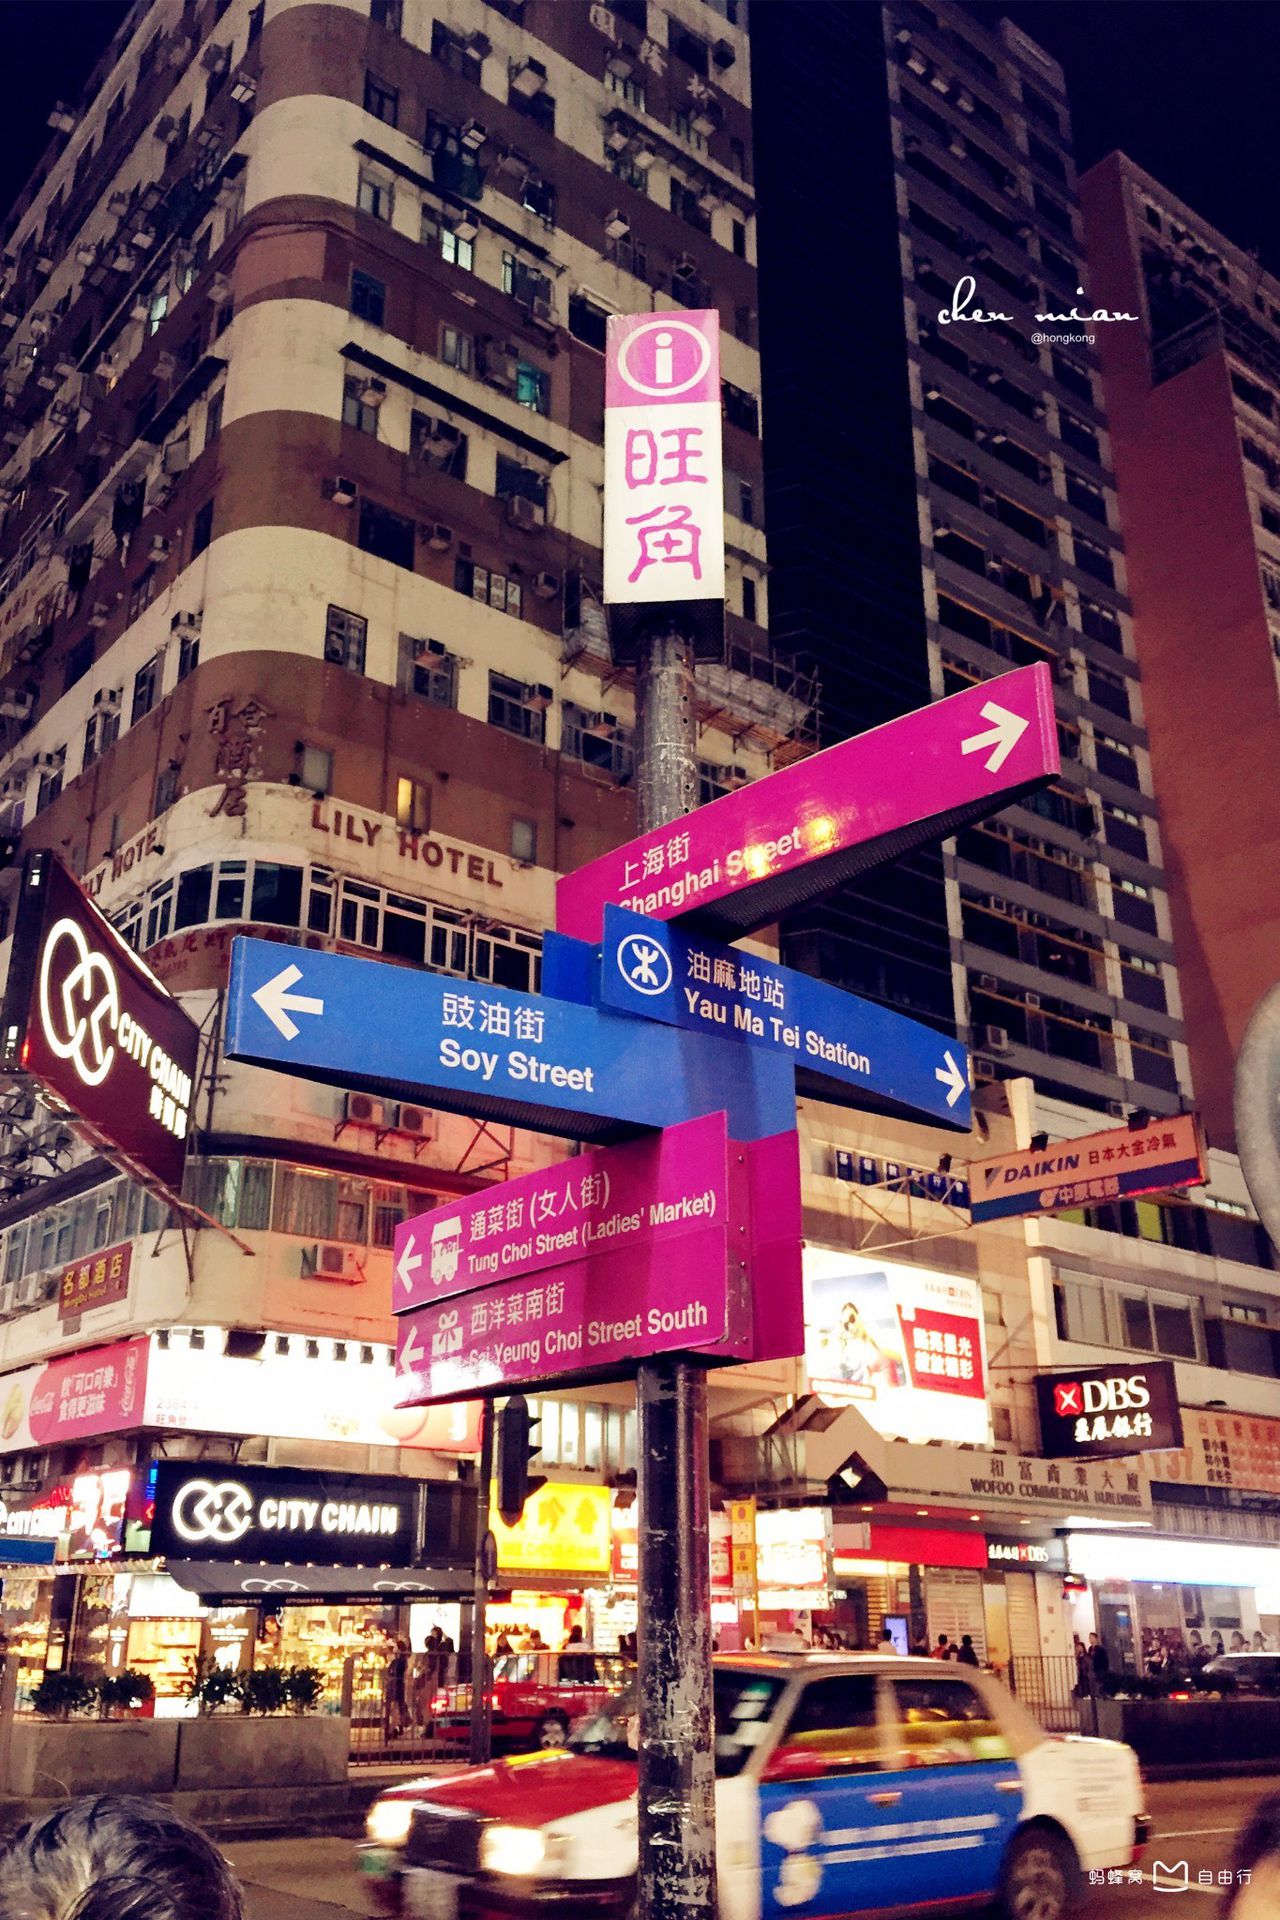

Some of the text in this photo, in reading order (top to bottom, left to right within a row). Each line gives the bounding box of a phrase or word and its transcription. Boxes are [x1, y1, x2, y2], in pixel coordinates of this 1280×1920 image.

[625, 427, 708, 584] 旺角
[111, 827, 158, 883] HOTE
[311, 804, 504, 888] LILY HOTEL
[618, 831, 690, 891] 上海街
[726, 826, 802, 877] Seet
[687, 948, 785, 1010] 油麻地站
[117, 1012, 153, 1068] CITY
[442, 992, 545, 1044] 豉油街
[684, 987, 871, 1075] Yau Ma Tei Station
[439, 1038, 594, 1092] Soy Street
[1004, 1153, 1080, 1183] DAIKIN
[1088, 1133, 1176, 1165] 日本大金冷氣
[468, 1189, 717, 1275] Tung Choi Street (Ladies' Market)
[469, 1170, 612, 1243] 通菜街 (女人街)
[470, 1281, 566, 1336] 西洋菜南街
[493, 1340, 541, 1365] Yeung
[545, 1324, 583, 1355] Choi
[587, 1313, 643, 1347] Street
[647, 1301, 708, 1335] South
[1081, 1374, 1151, 1413] DBS
[259, 1499, 399, 1535] CITY CHAIN
[970, 1478, 1142, 1508] WOFOO COMMERCIAL BUILDING
[1027, 1545, 1049, 1562] DBS
